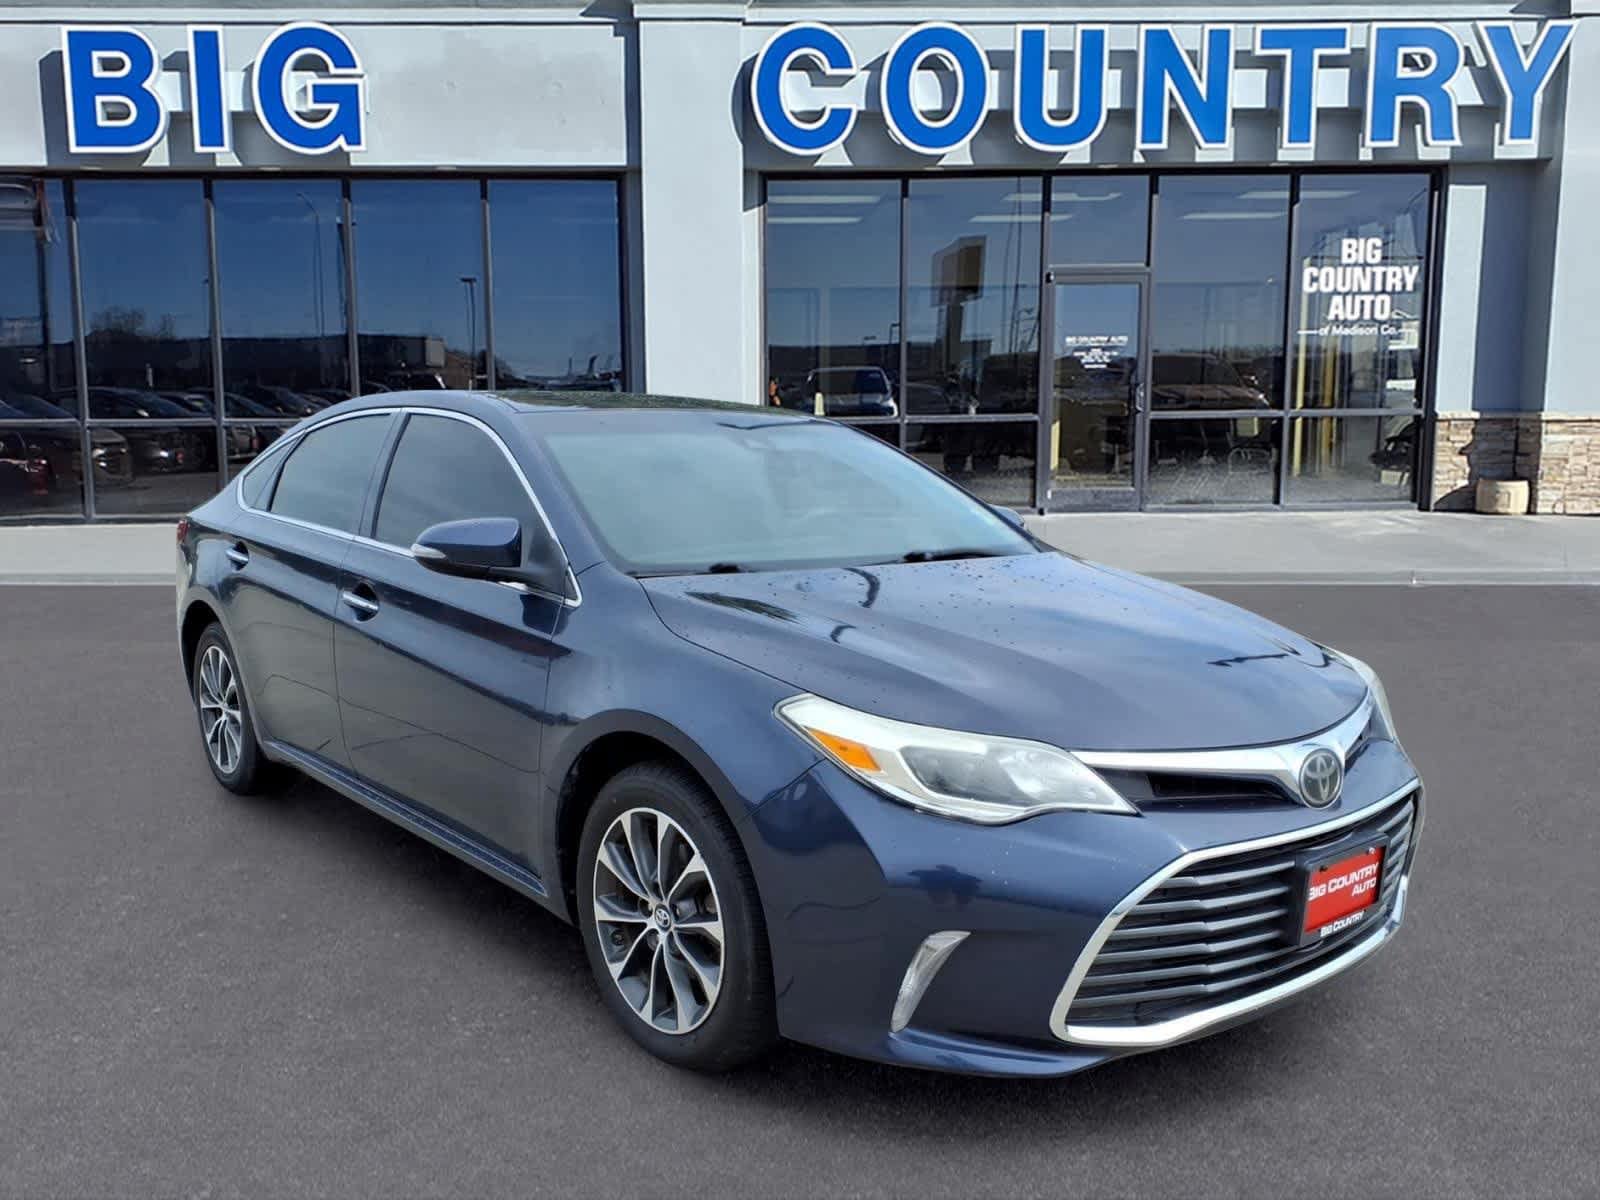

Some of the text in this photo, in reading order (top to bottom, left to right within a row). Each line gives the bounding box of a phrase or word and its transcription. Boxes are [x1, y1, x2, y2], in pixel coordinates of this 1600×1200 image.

[62, 20, 1577, 156] BIG COUNTRY
[1341, 237, 1382, 265] BIG
[1303, 265, 1419, 293] COUNTRY
[1328, 294, 1391, 321] AUTO
[1319, 324, 1399, 336] of Madison Co.
[1328, 862, 1379, 893] COUNTRY
[1351, 878, 1377, 896] AUTO
[1320, 912, 1364, 937] BIG COUNTRY
